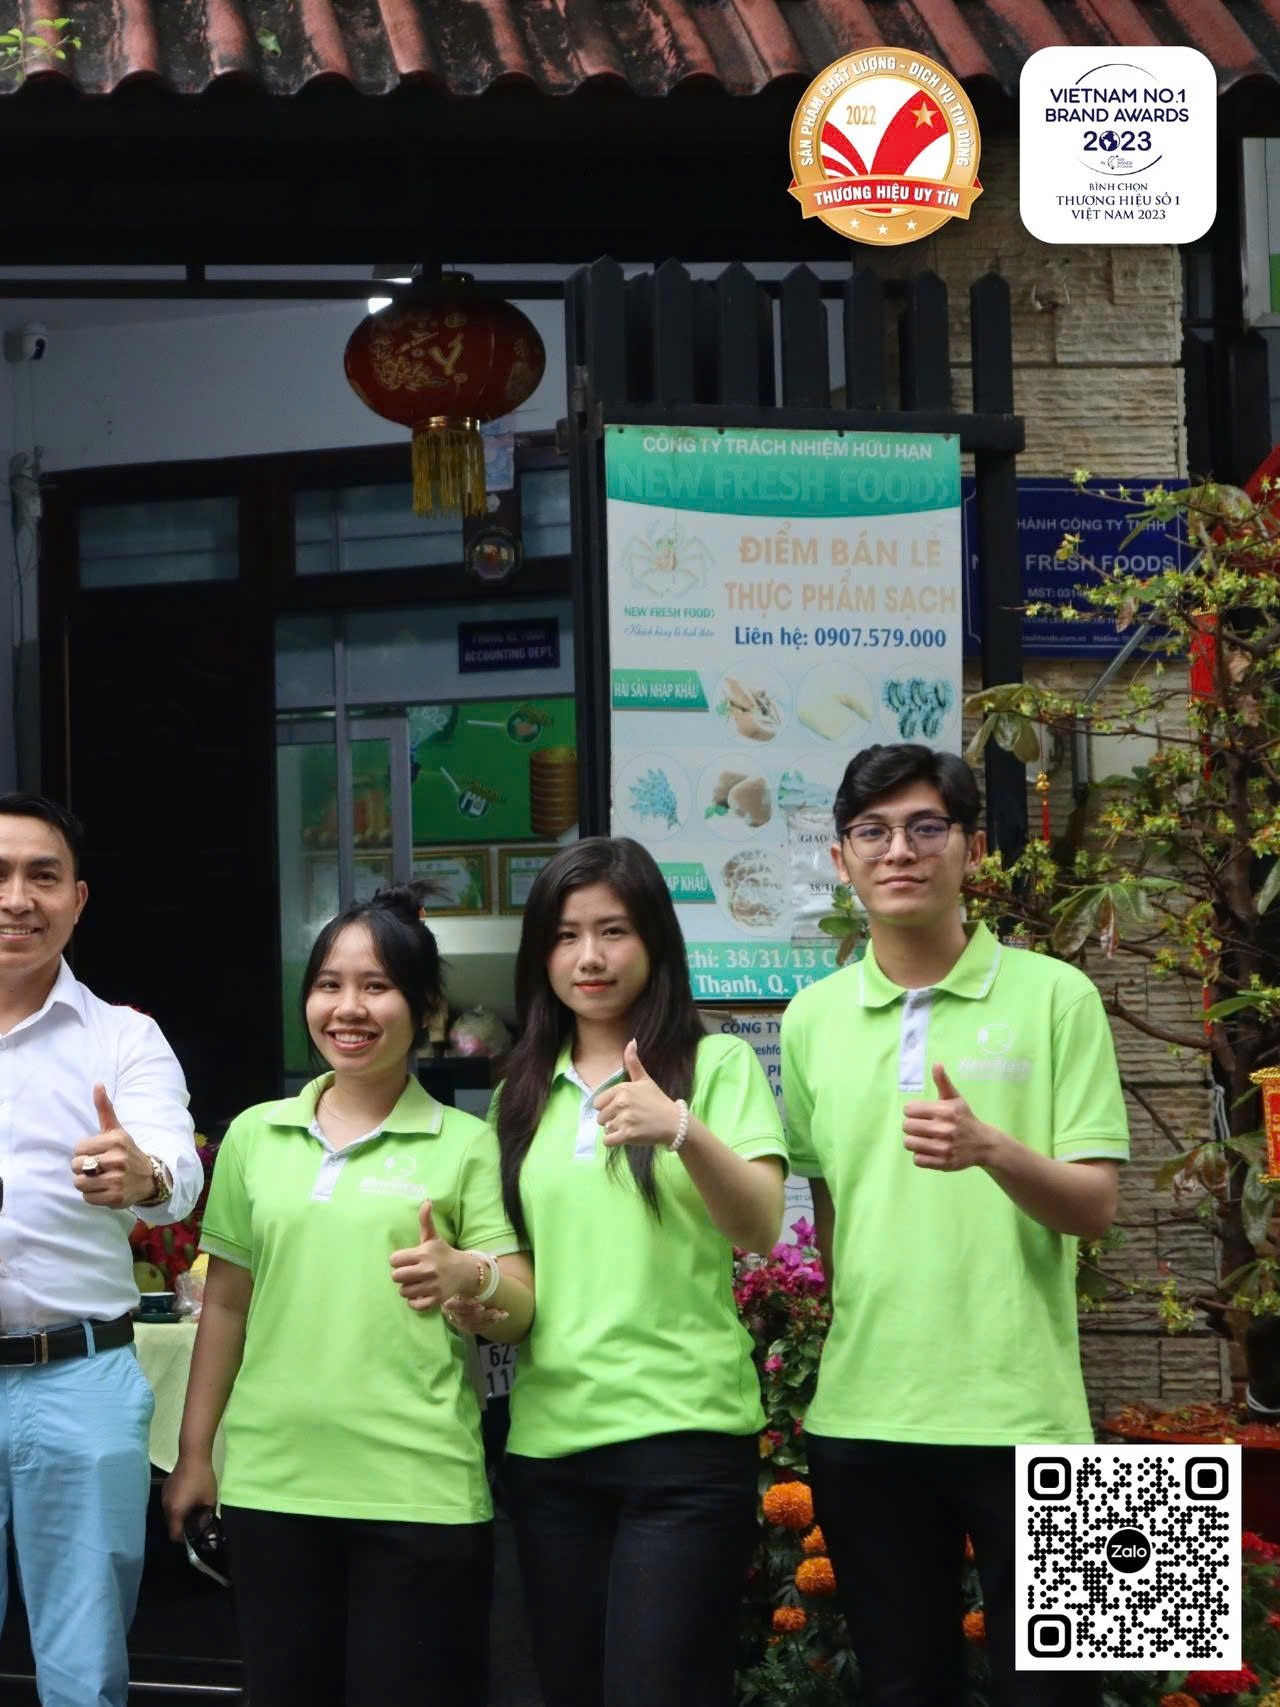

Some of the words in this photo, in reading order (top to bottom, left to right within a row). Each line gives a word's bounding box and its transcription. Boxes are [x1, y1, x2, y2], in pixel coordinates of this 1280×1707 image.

[642, 436, 696, 453] CÔNG
[700, 438, 720, 453] TY
[791, 439, 845, 460] NHIỆM
[895, 444, 932, 460] HẠN
[620, 462, 704, 498] NEW
[715, 464, 822, 501] FRESH
[1017, 518, 1056, 530] HÁNH
[1106, 520, 1123, 531] TY
[739, 521, 818, 565] ĐIỂM
[831, 530, 897, 567] BÁN
[1025, 555, 1095, 571] FRESH
[1102, 555, 1175, 572] FOODS
[725, 579, 792, 618] THỰC
[801, 568, 875, 613] PHẨM
[885, 586, 955, 620] SẠCH
[624, 607, 648, 617] NEW
[650, 607, 681, 617] FRESH
[735, 626, 774, 645] Liên
[780, 627, 808, 650] hệ:
[814, 627, 946, 648] 0907.579.000
[727, 948, 817, 969] 38/31/13
[696, 973, 762, 997] Thạnh,
[770, 975, 789, 993] Q.
